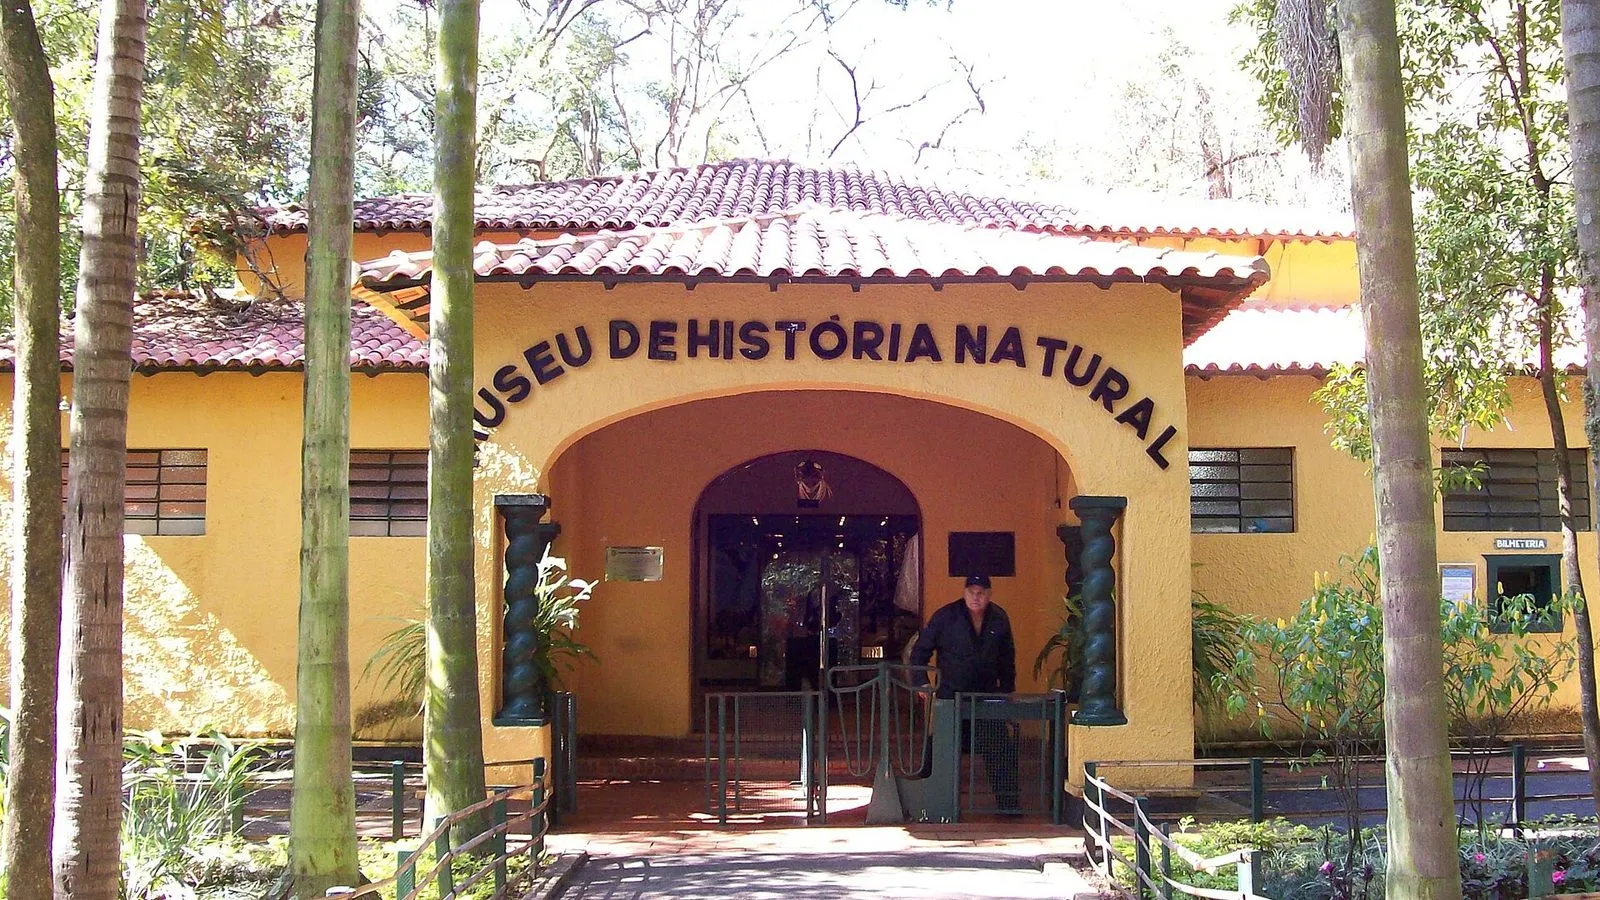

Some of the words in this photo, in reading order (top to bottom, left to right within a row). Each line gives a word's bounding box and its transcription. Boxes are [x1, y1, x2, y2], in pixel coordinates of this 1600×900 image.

[608, 319, 678, 361] DE
[954, 324, 1178, 470] NATURAL
[1496, 539, 1545, 548] BILHETERIA
